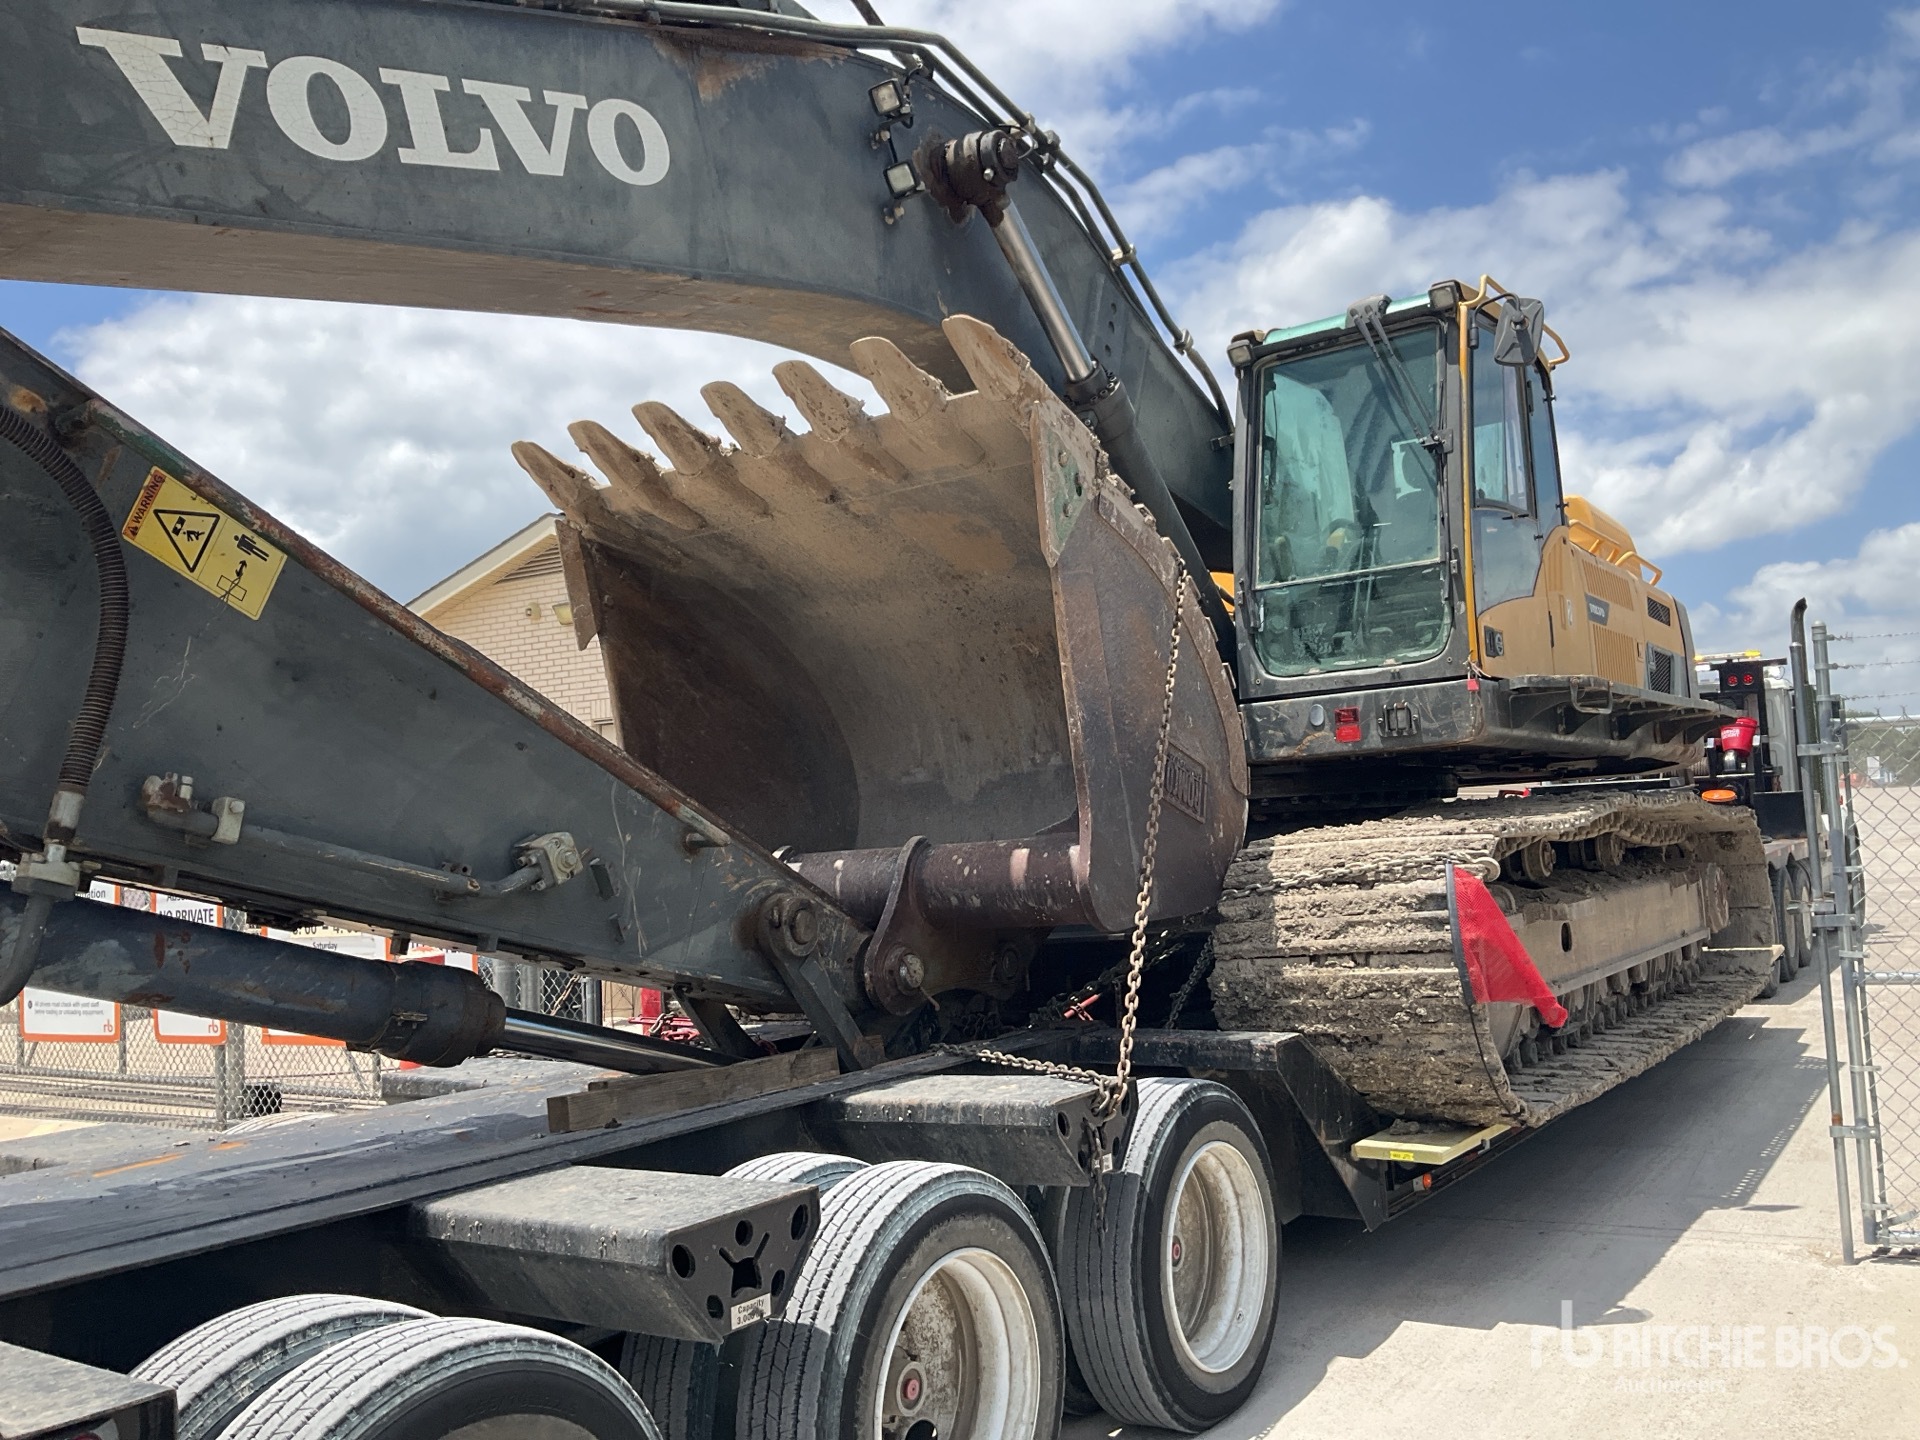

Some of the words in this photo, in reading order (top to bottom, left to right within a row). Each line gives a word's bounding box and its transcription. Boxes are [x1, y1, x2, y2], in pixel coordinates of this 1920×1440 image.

[76, 26, 670, 185] VOLVO
[132, 473, 165, 525] WARNING
[175, 908, 214, 923] PRIVATE
[312, 940, 338, 951] Saturday
